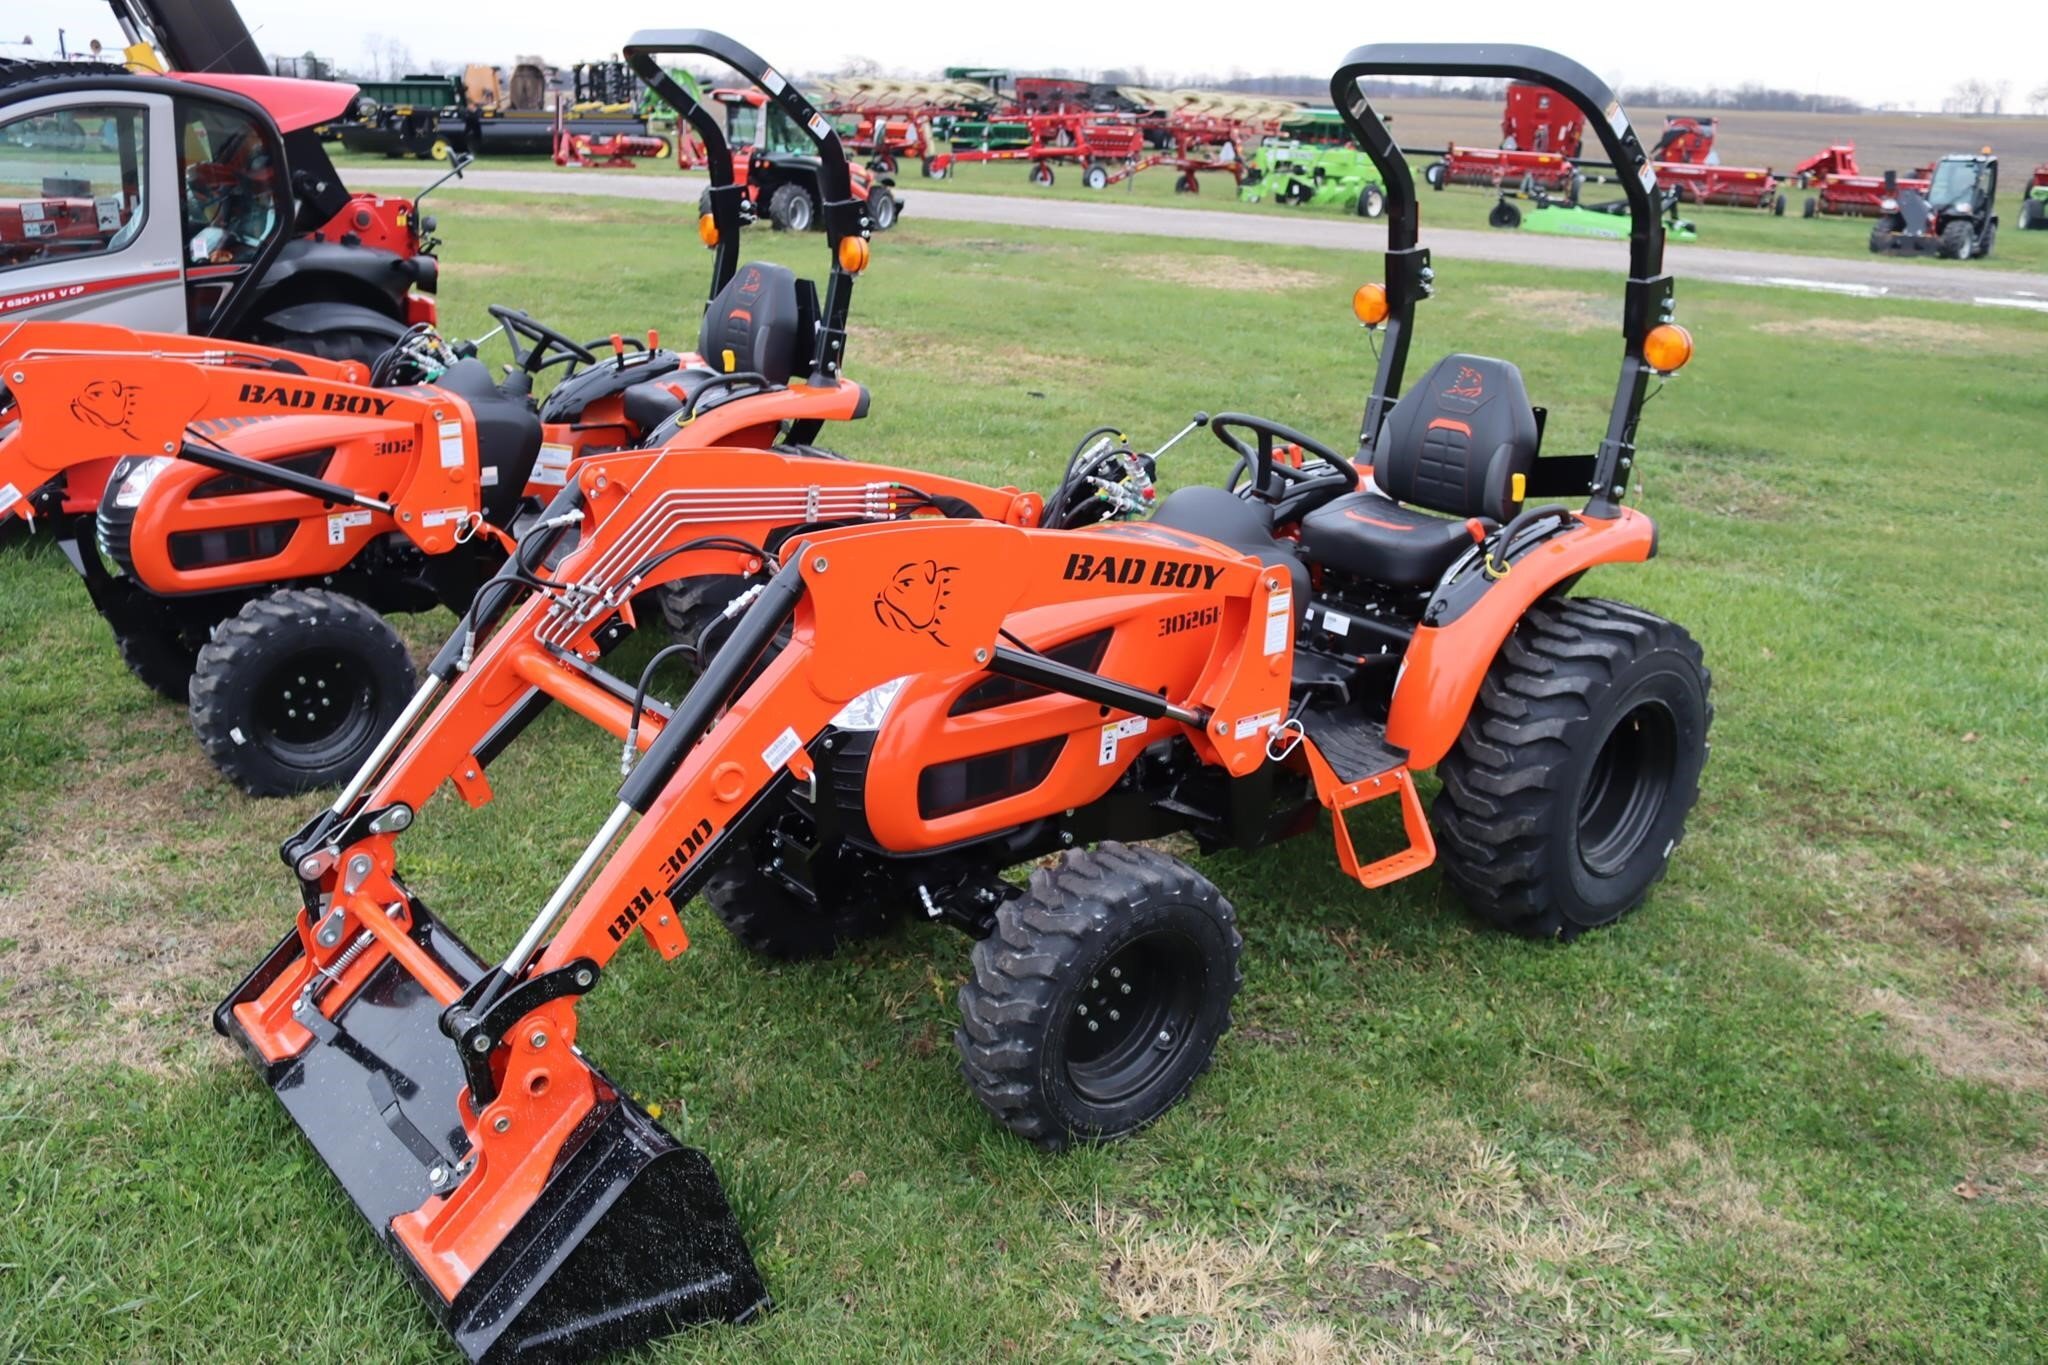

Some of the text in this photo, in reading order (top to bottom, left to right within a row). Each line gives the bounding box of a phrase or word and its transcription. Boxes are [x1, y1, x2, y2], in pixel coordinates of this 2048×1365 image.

[6, 291, 56, 308] 630-115
[238, 384, 394, 416] BAD BOY
[1062, 553, 1225, 590] BAD BOY
[607, 818, 713, 942] BBL 300
